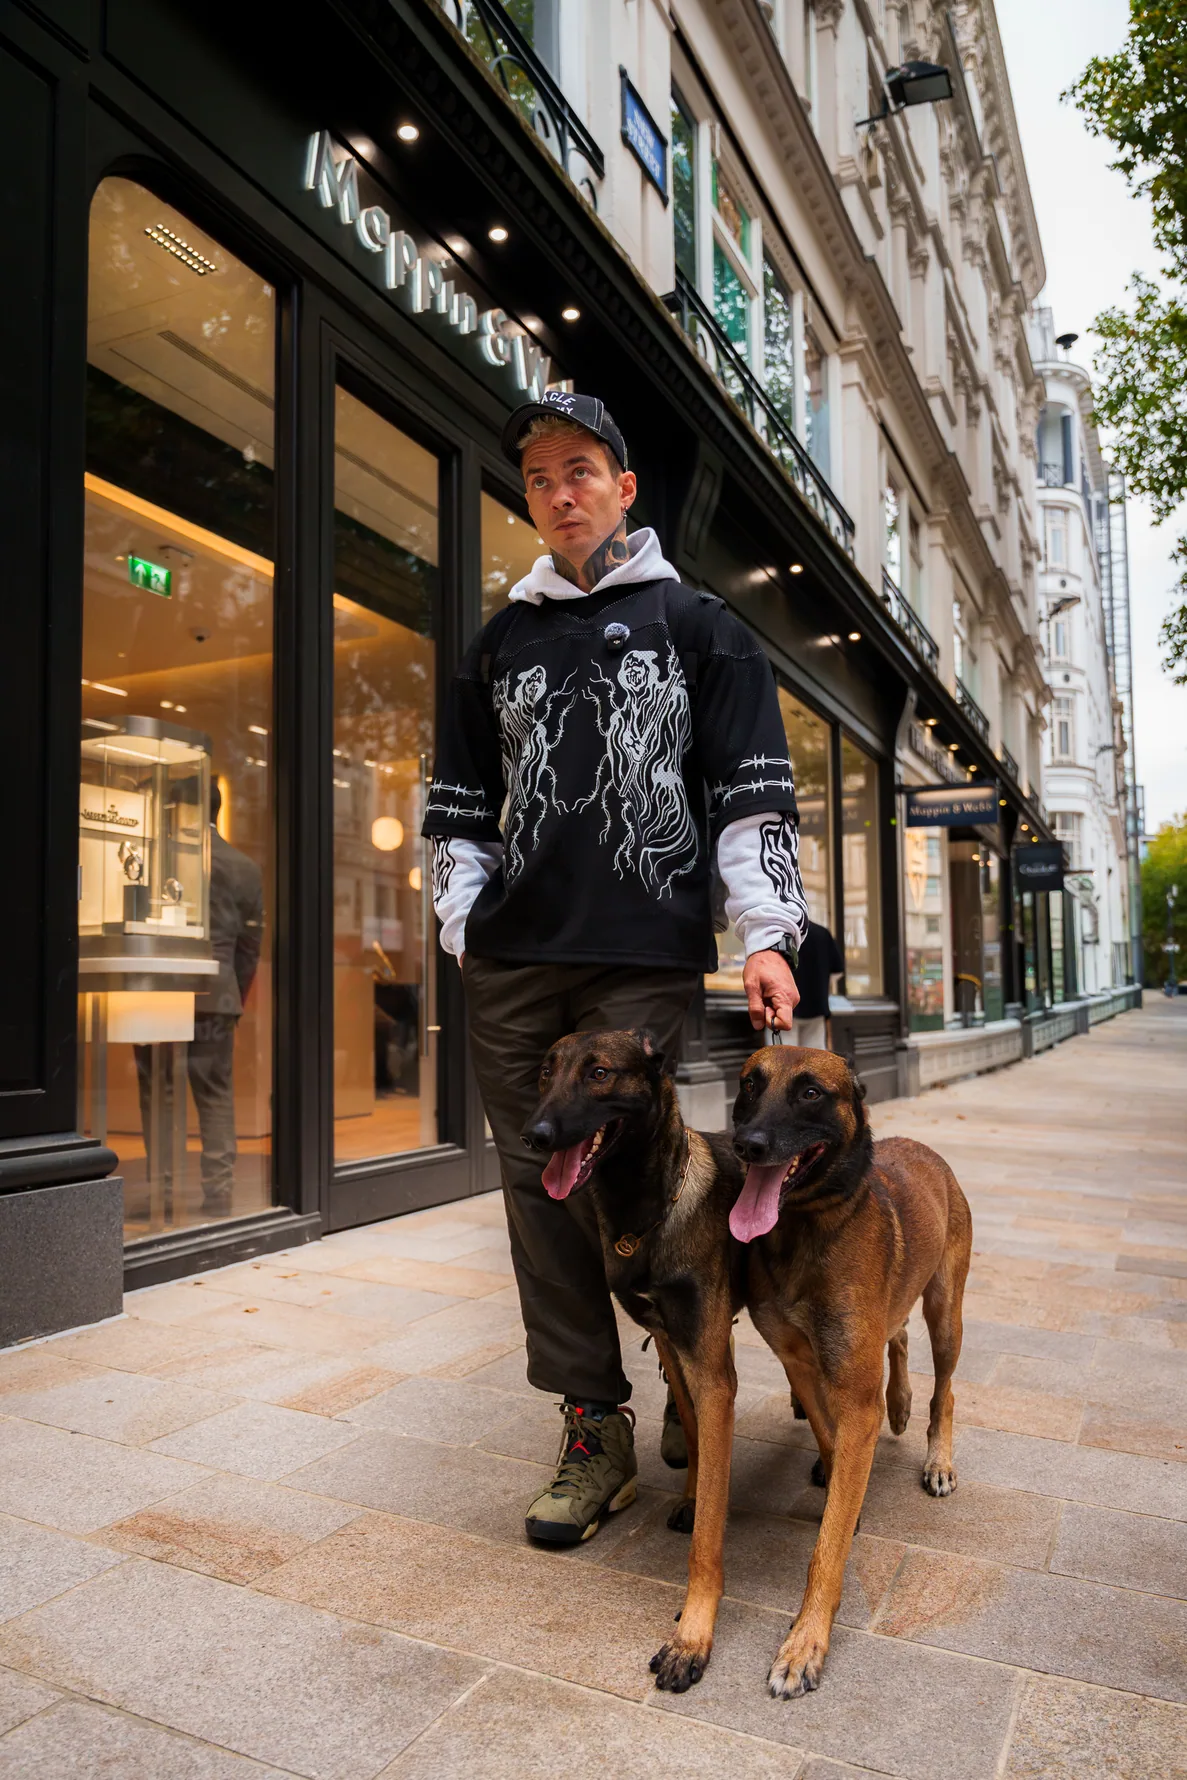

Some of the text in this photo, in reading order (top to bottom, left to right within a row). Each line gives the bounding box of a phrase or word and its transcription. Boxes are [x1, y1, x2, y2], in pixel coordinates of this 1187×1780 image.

[304, 128, 477, 335] Mappin
[537, 392, 577, 406] ACLE
[909, 801, 993, 819] Mappin & Webb
